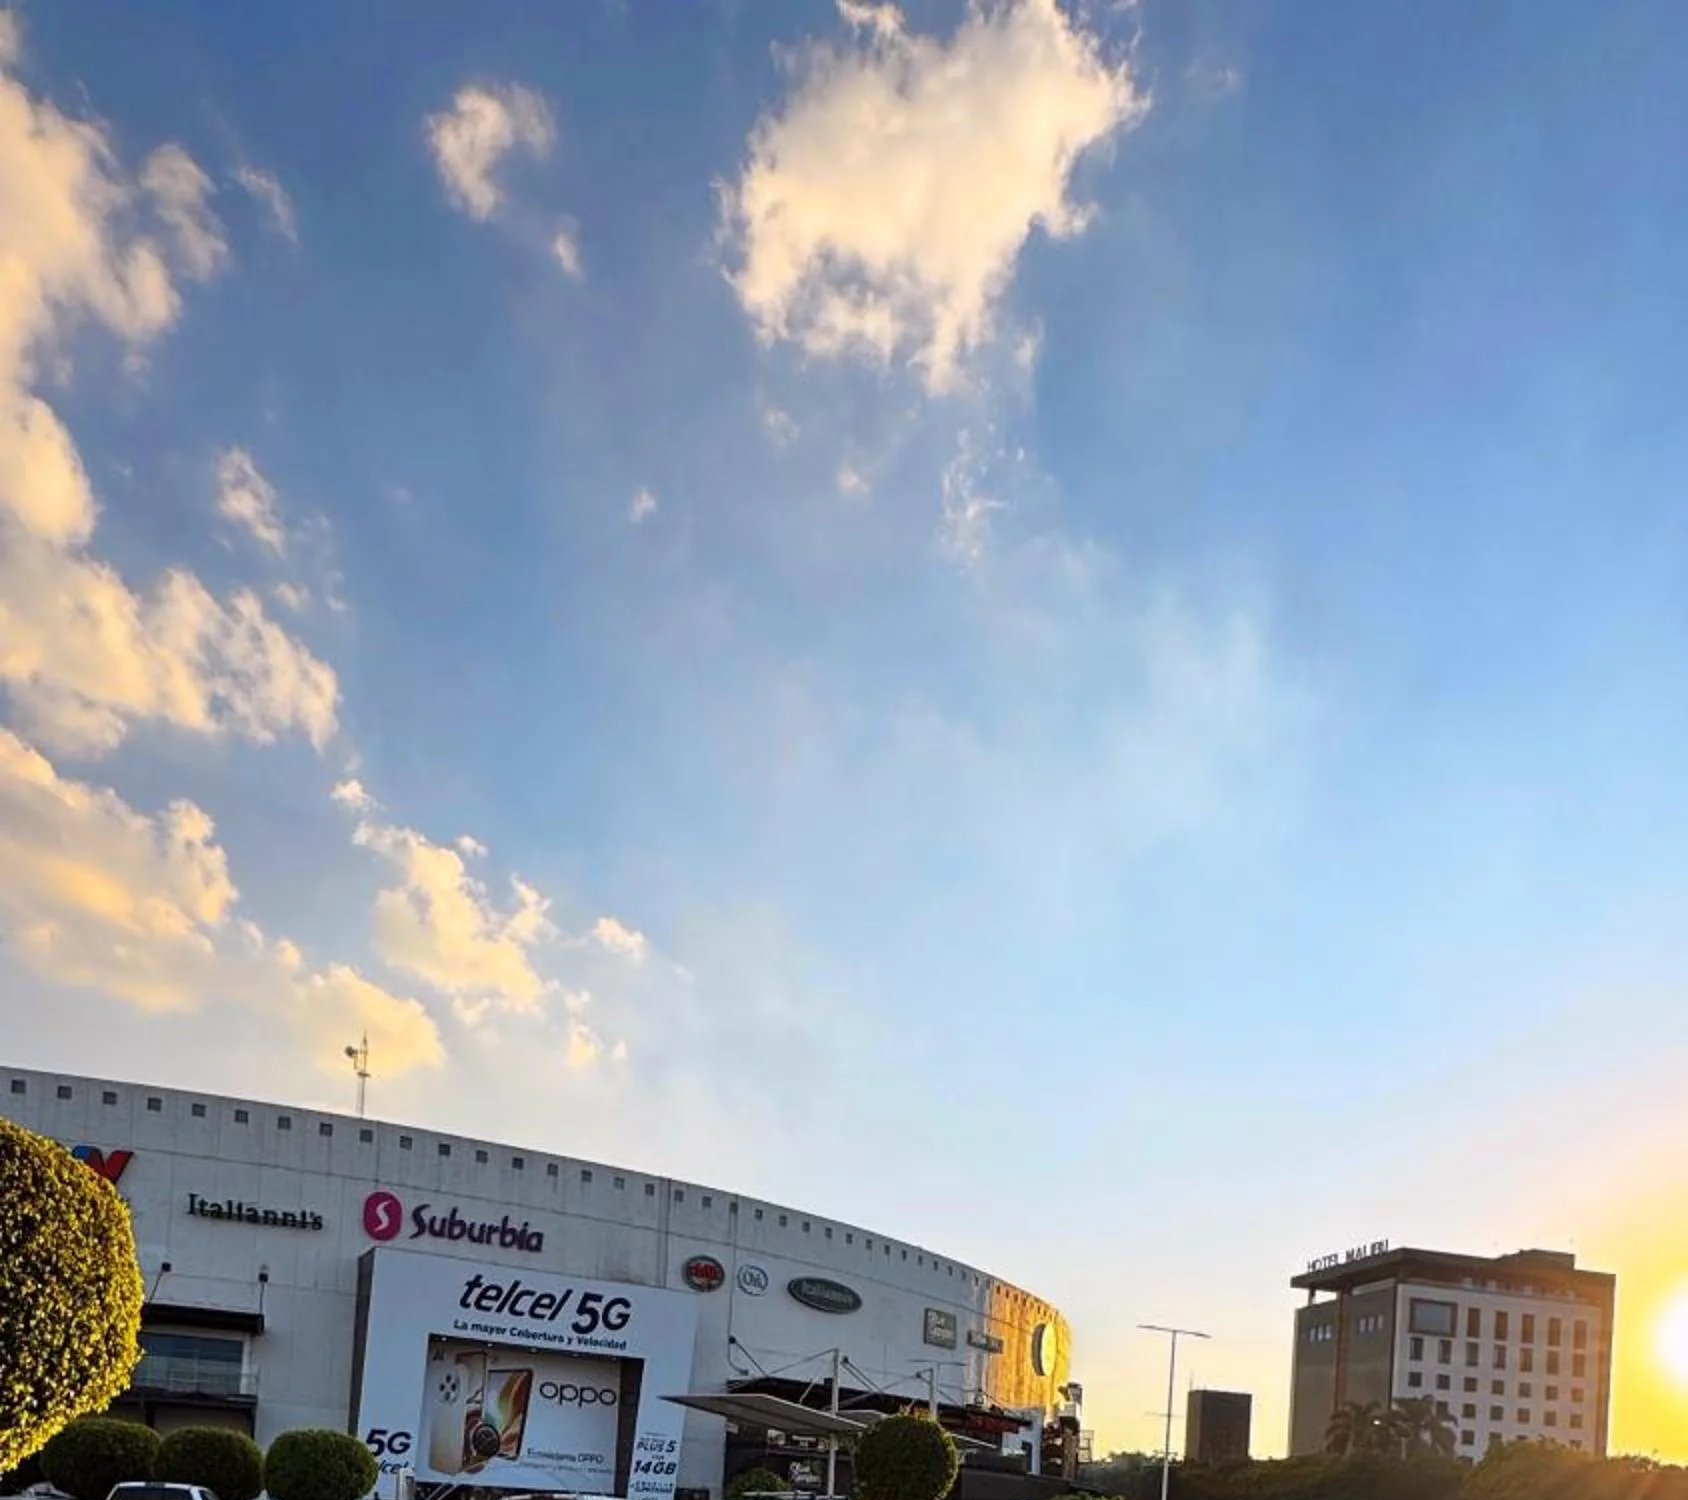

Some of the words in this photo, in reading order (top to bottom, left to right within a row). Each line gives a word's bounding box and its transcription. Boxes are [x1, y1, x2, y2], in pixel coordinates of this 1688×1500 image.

[187, 1193, 323, 1231] Italianni's
[409, 1203, 545, 1253] Suburbia
[459, 1274, 573, 1321] telcel
[571, 1291, 632, 1335] 5G
[453, 1319, 468, 1331] La
[471, 1322, 507, 1335] mayor
[567, 1335, 573, 1346] y
[366, 1429, 411, 1457] 5G
[665, 1440, 677, 1453] 5
[634, 1460, 677, 1475] 14GB
